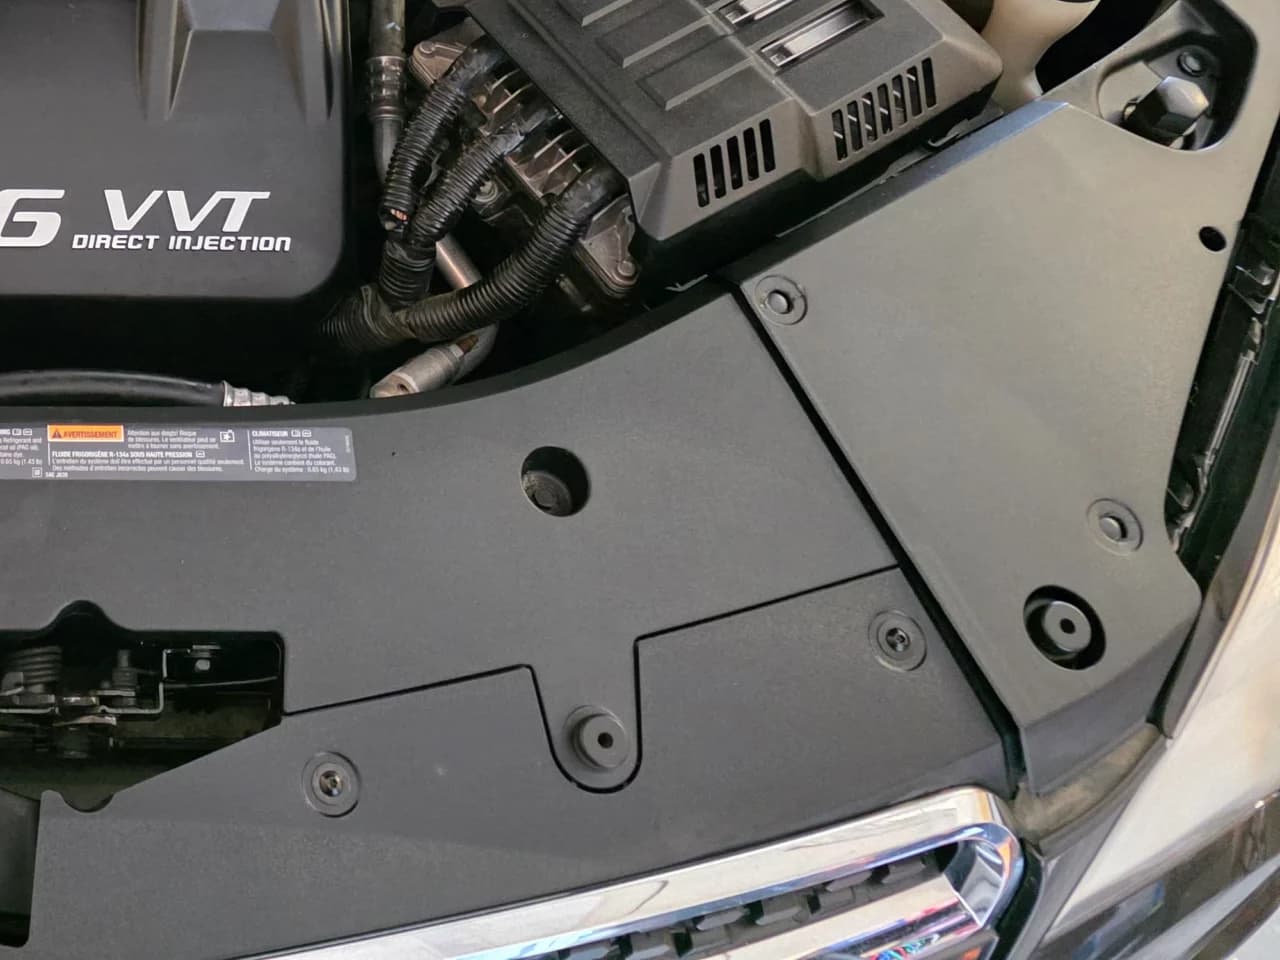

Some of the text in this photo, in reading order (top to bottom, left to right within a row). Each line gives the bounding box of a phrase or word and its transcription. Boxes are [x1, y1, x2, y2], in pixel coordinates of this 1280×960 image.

[104, 189, 271, 232] VVT
[72, 234, 291, 252] DIRECT INJECTION
[63, 430, 118, 439] AVERTISSEMENT
